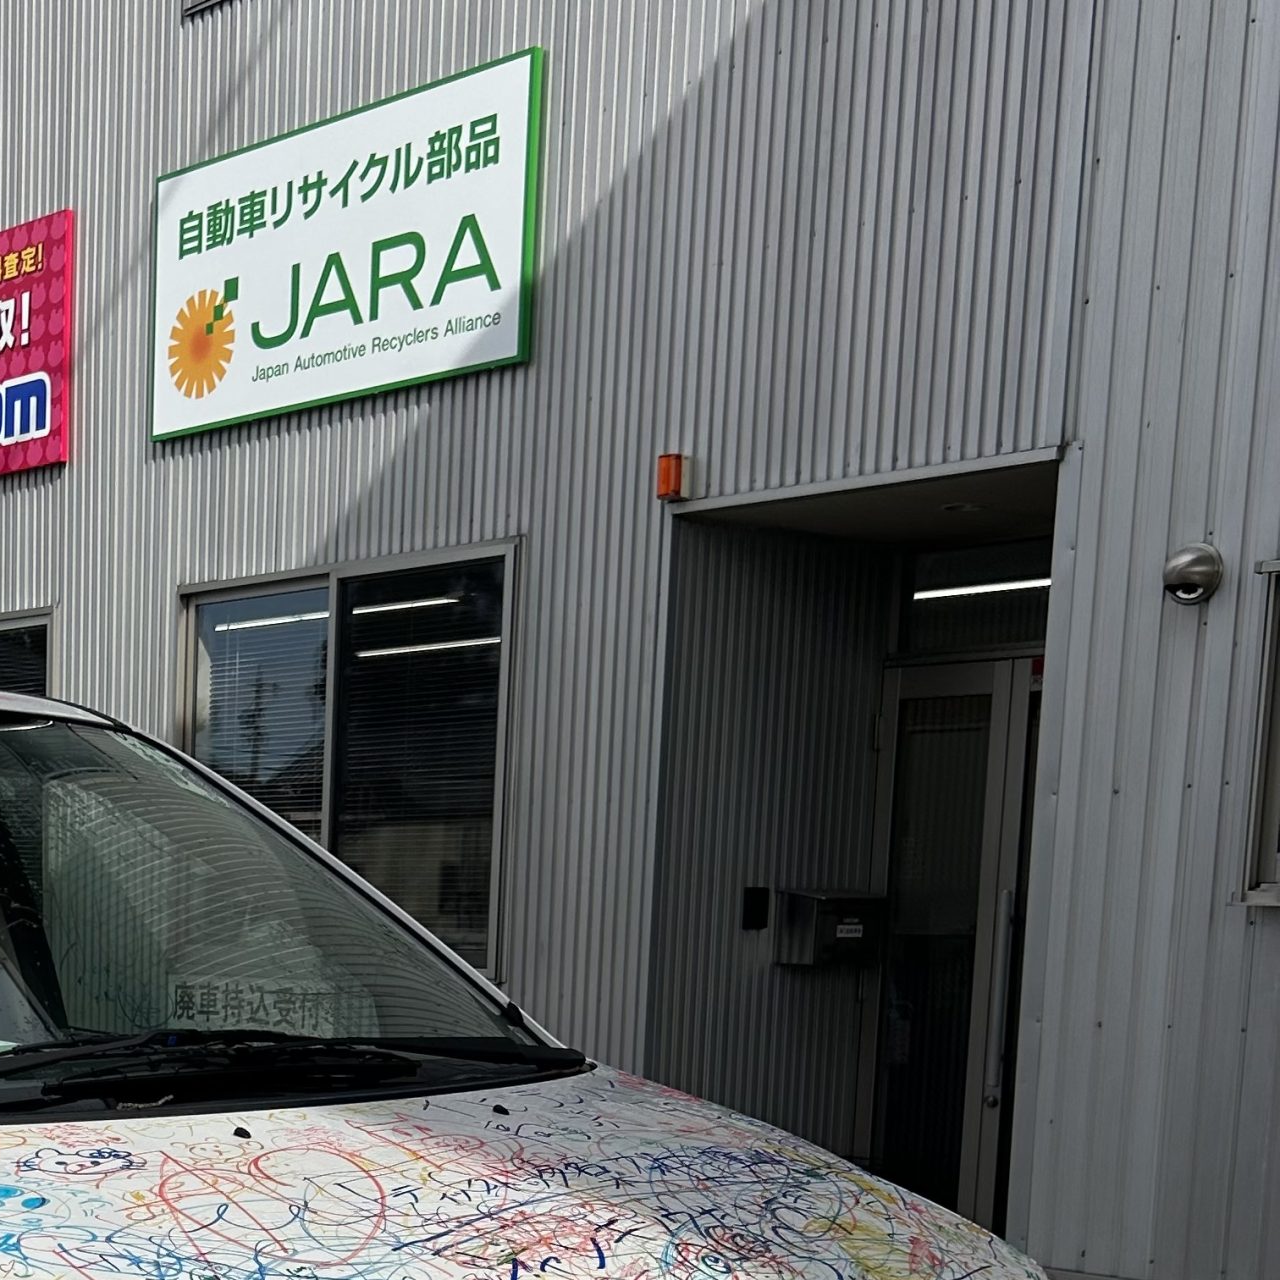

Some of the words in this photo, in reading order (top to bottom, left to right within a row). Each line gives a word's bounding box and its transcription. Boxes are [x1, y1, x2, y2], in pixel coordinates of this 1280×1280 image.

[178, 113, 500, 260] 自動車リサイクル部品
[250, 213, 502, 350] JARA
[251, 361, 289, 384] Japan
[293, 341, 367, 373] Automotive
[371, 325, 439, 356] Recyclers
[444, 311, 501, 338] Alliance
